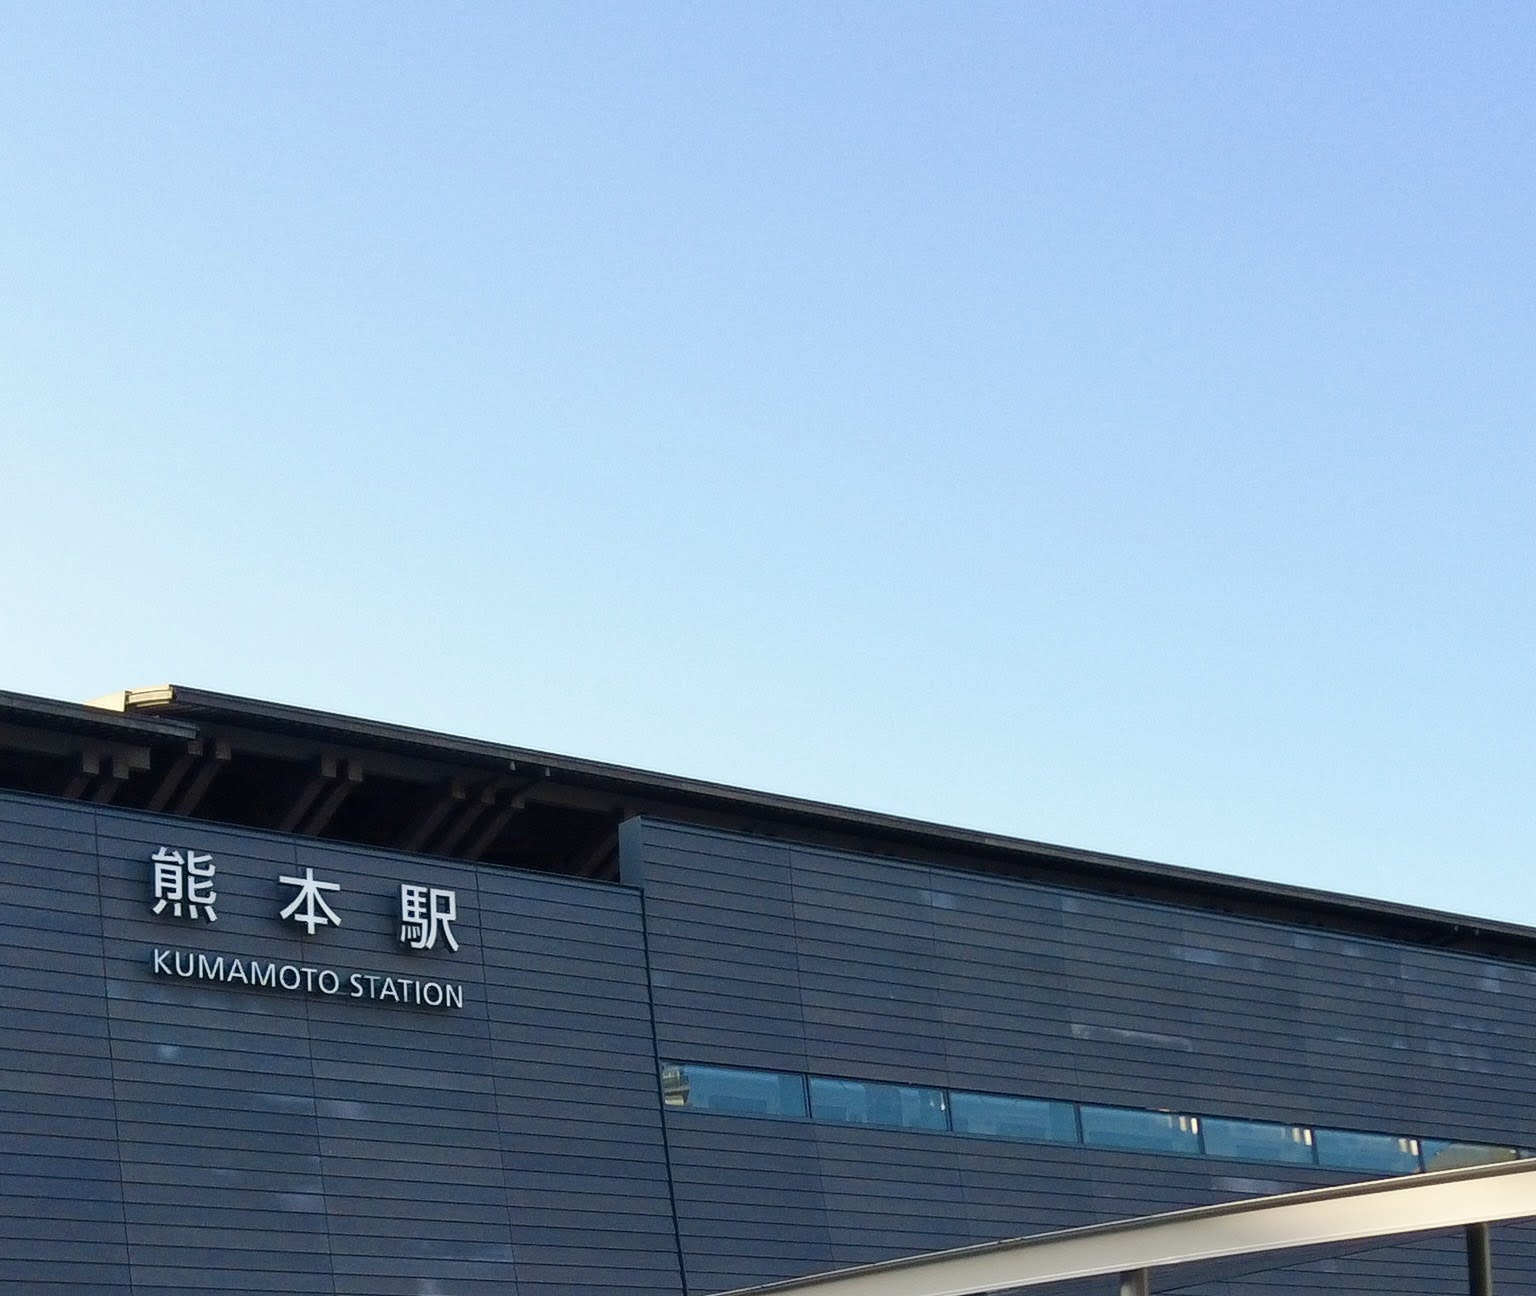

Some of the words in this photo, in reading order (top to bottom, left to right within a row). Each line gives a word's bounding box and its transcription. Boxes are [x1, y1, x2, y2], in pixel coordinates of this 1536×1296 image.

[151, 847, 459, 952] 熊本駅
[153, 948, 341, 995] KUMAMOTO
[350, 973, 463, 1008] STATION
